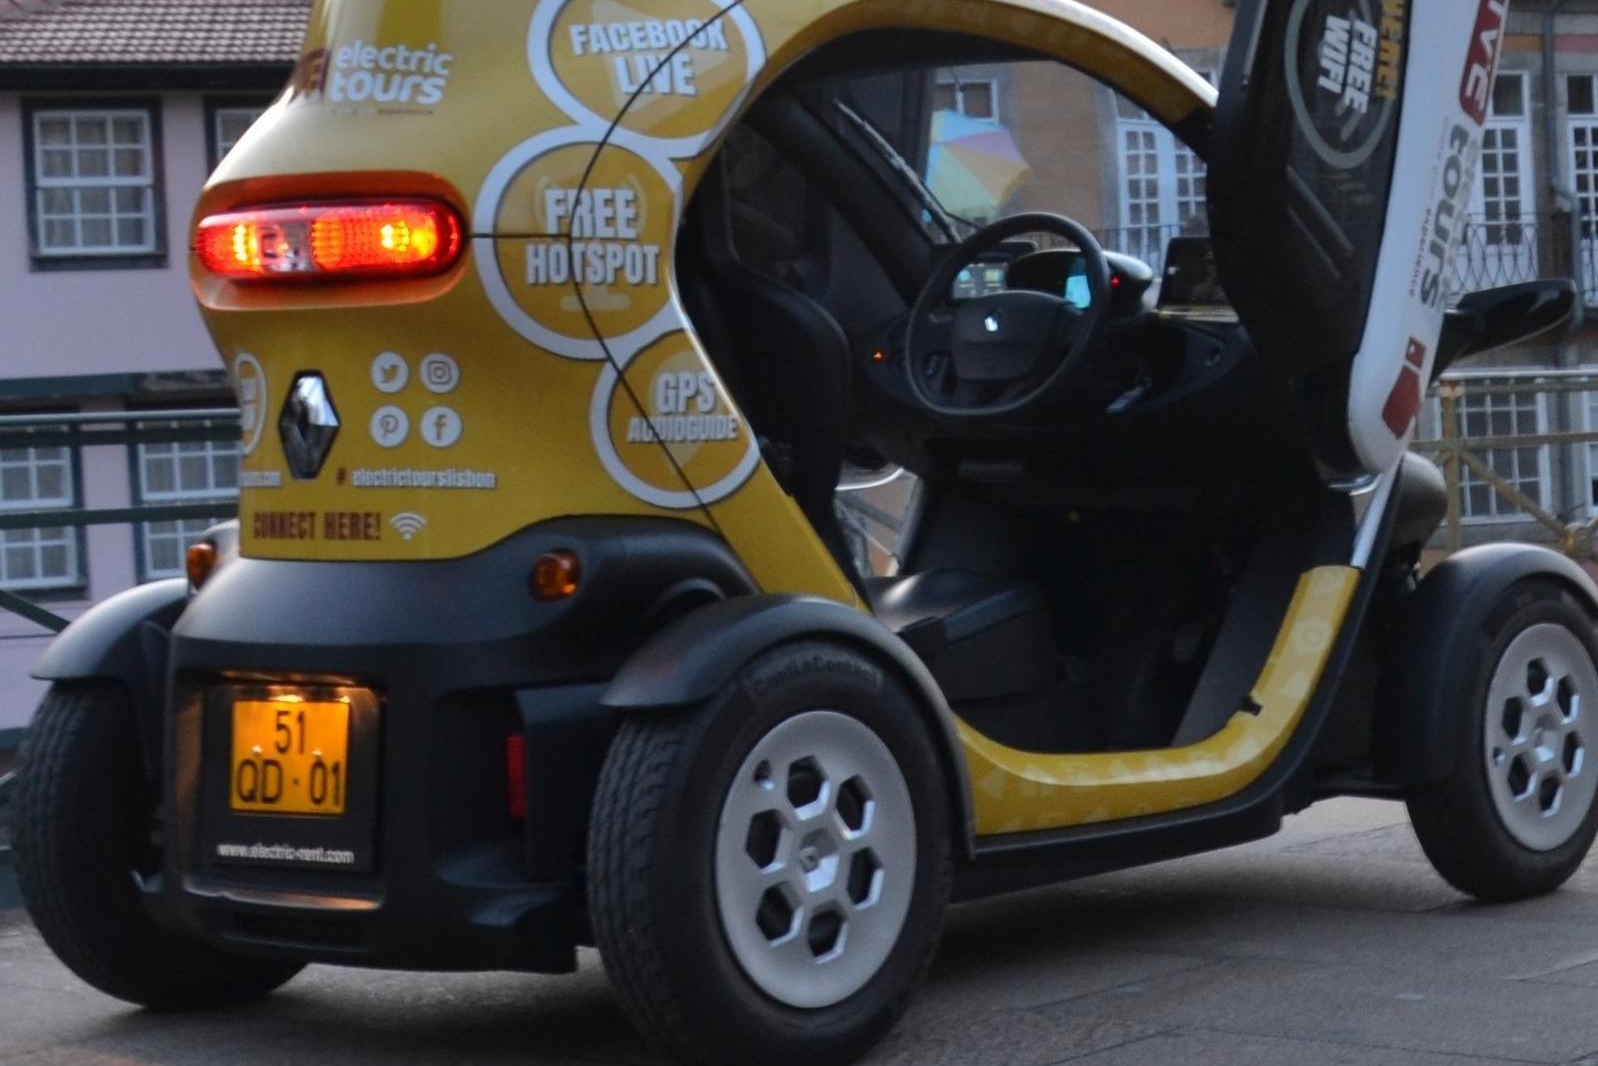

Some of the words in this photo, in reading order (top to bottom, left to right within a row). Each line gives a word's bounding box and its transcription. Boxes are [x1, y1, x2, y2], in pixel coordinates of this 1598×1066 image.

[335, 38, 454, 76] electric
[569, 18, 729, 55] FACEBOOK
[1317, 15, 1352, 94] WIFI
[330, 70, 448, 106] tours
[615, 53, 698, 96] LIVE
[1343, 19, 1378, 114] FREE
[544, 188, 638, 239] FREE
[1420, 123, 1471, 309] tours
[526, 243, 660, 286] HOTSPOT
[656, 371, 719, 414] GPS
[254, 512, 317, 540] CONNECT
[323, 512, 382, 541] HERE!
[274, 710, 306, 754] 51
[217, 842, 355, 864] www.electric-rent.com
